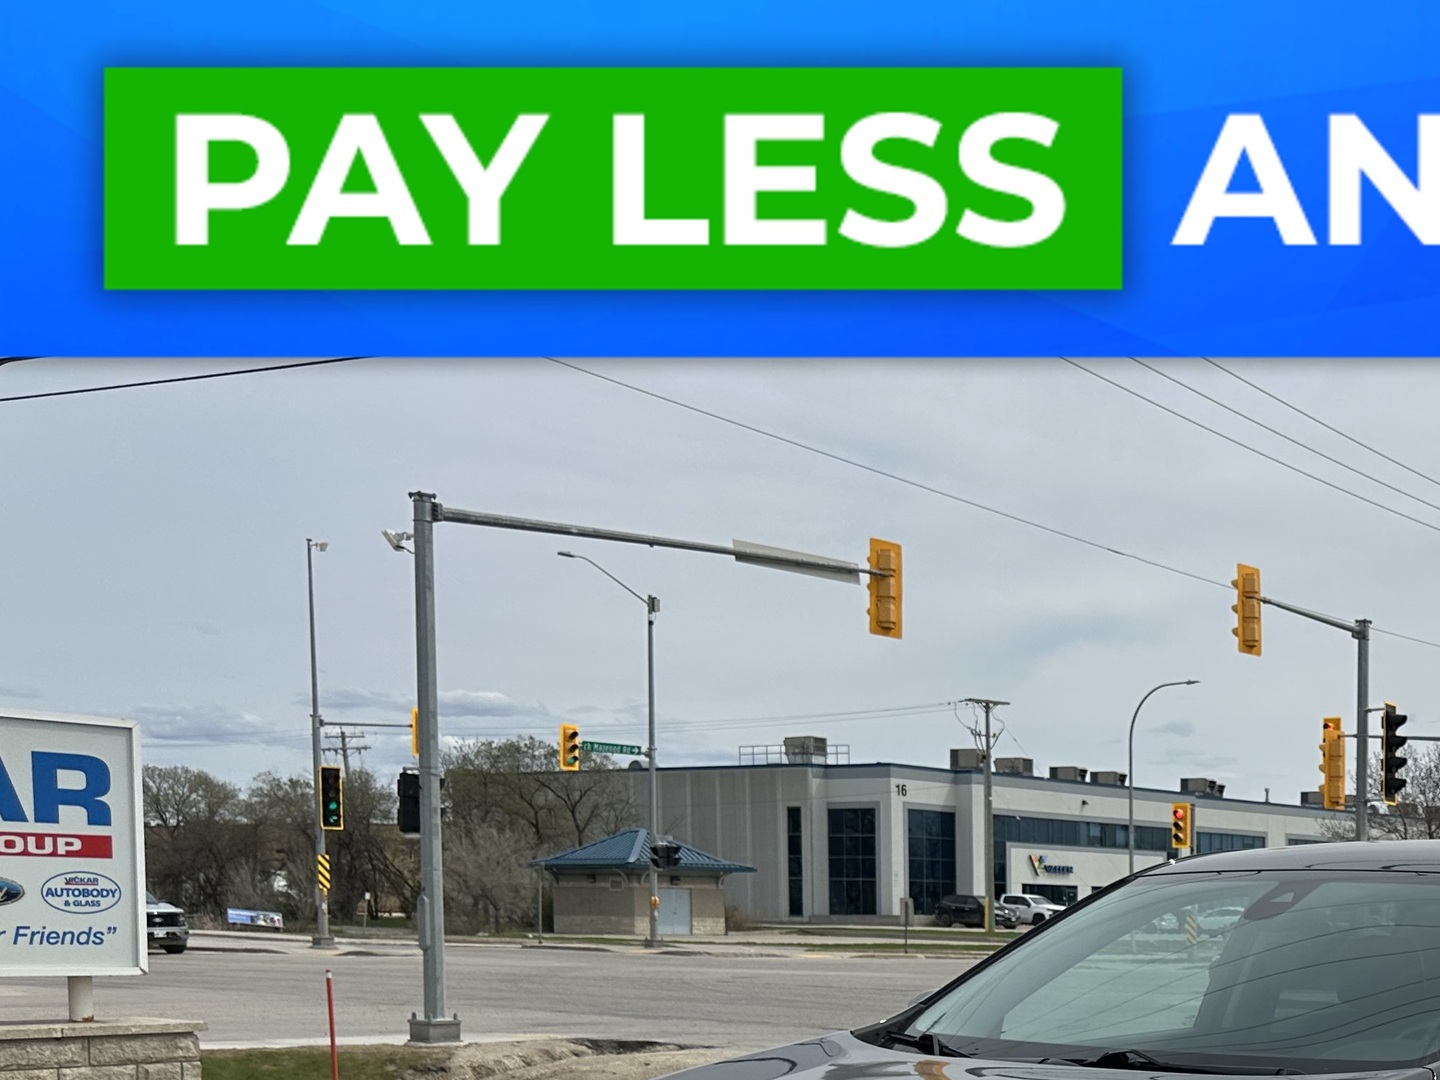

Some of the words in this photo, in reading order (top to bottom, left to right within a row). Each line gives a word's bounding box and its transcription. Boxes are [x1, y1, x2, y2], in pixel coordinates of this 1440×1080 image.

[895, 784, 907, 796] 16
[64, 876, 99, 885] VICKAR
[45, 887, 118, 898] AUTOBODY
